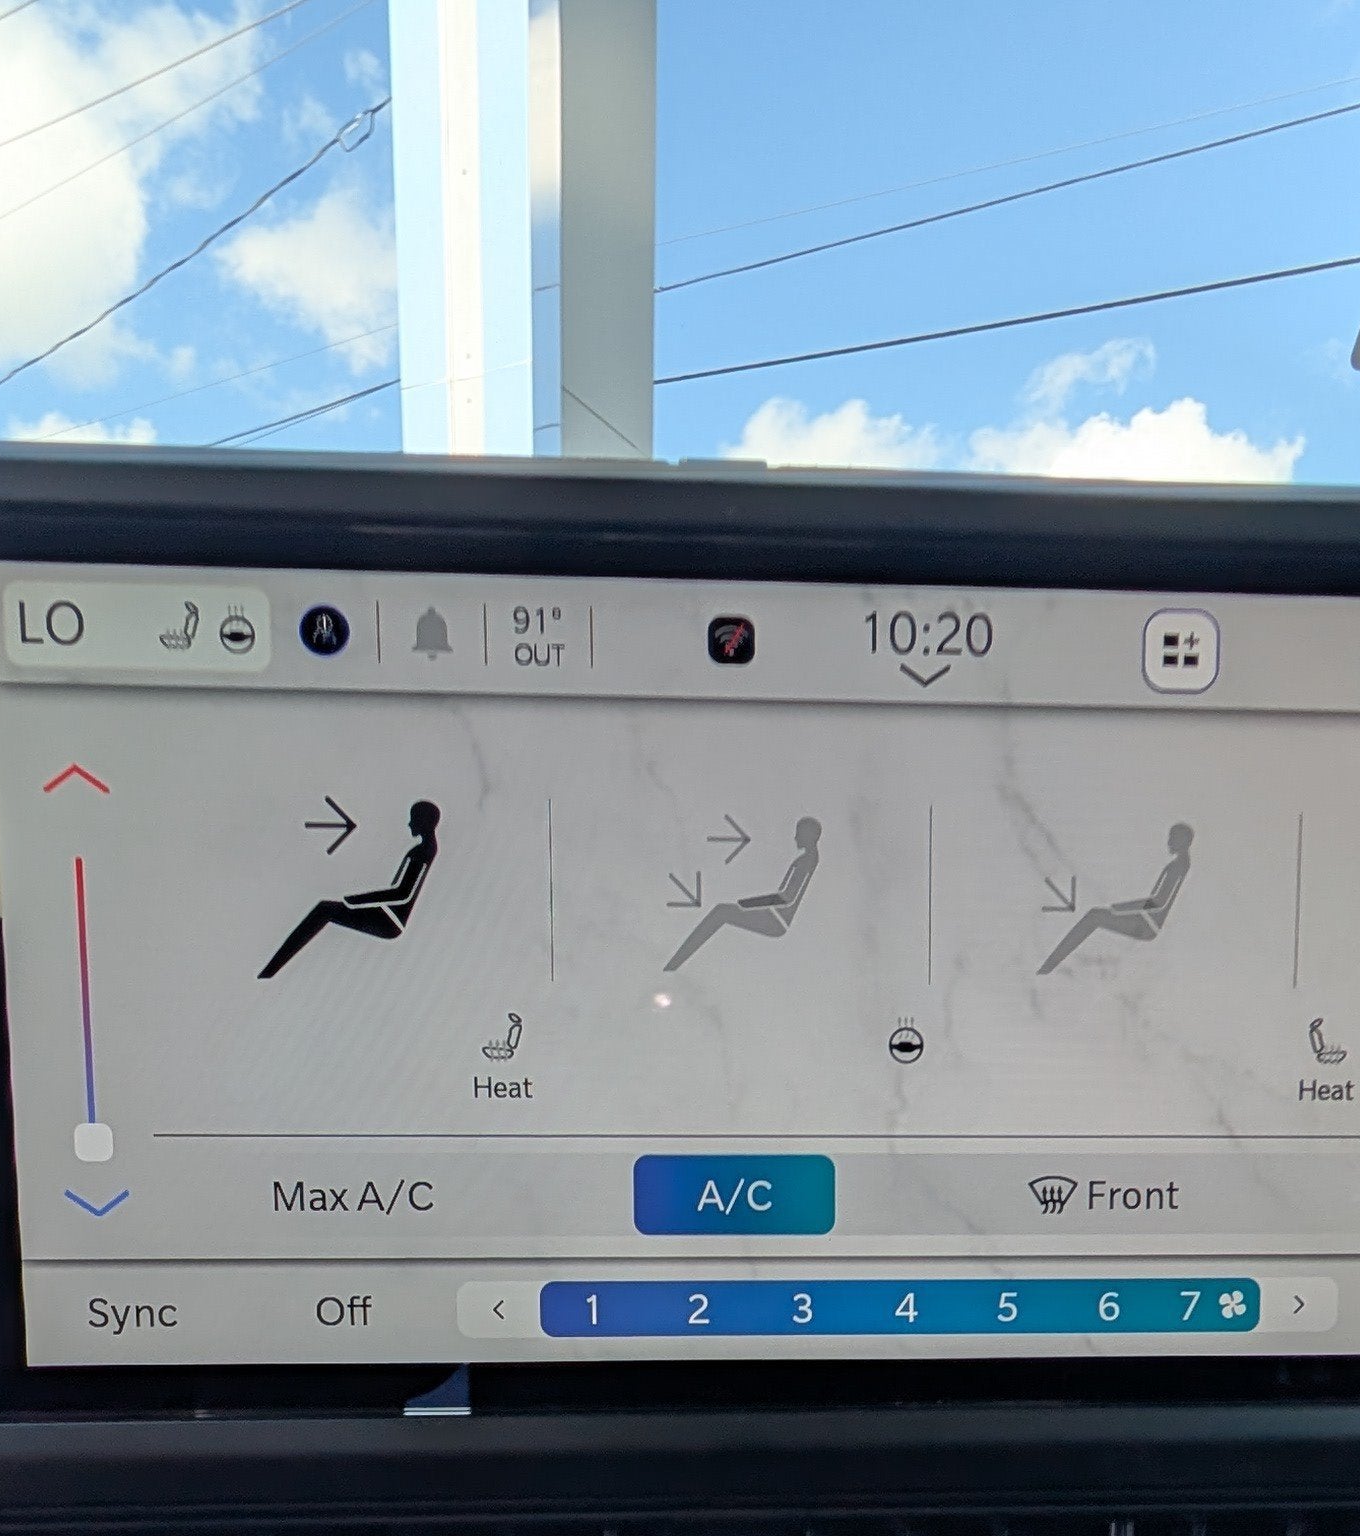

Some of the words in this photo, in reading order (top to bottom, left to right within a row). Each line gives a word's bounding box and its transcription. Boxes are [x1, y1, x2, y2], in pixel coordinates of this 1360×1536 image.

[19, 600, 84, 645] LO
[862, 610, 995, 658] 10:20
[513, 643, 566, 668] OUT
[472, 1076, 534, 1100] Heat
[1298, 1078, 1355, 1102] Heat
[272, 1180, 349, 1213] Max
[355, 1179, 436, 1215] A/C
[696, 1178, 774, 1216] A/C
[1088, 1179, 1181, 1211] Front
[87, 1298, 179, 1335] Sync
[316, 1295, 373, 1328] Off
[584, 1294, 601, 1326] 1
[686, 1293, 711, 1326] 2
[791, 1293, 814, 1325] 3
[894, 1292, 920, 1325] 4
[996, 1292, 1019, 1324] 5
[1097, 1291, 1121, 1322] 6
[1179, 1291, 1202, 1321] 7
